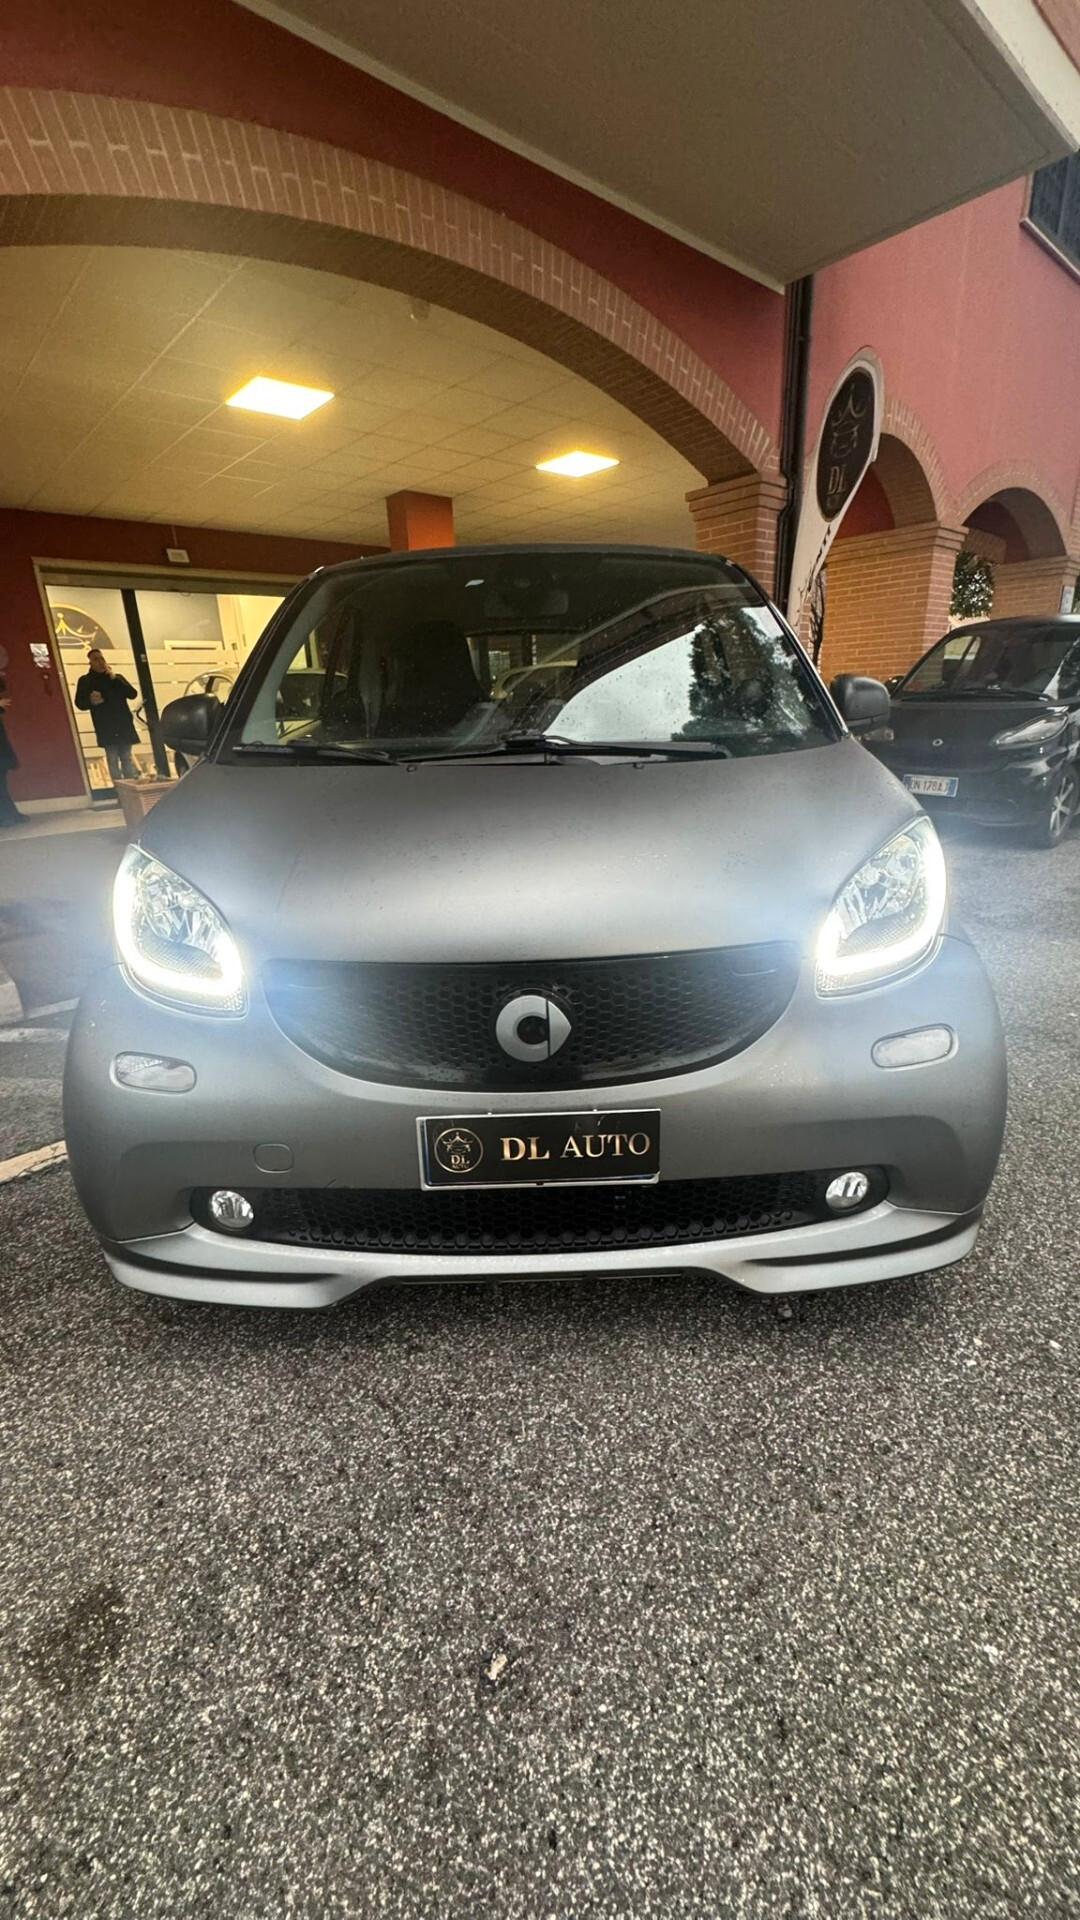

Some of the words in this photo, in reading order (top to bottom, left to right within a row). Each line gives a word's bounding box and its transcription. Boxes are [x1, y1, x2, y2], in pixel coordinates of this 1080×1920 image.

[826, 464, 846, 495] DL
[450, 1154, 470, 1164] DL
[500, 1136, 550, 1161] DL
[559, 1132, 650, 1158] AUTO
